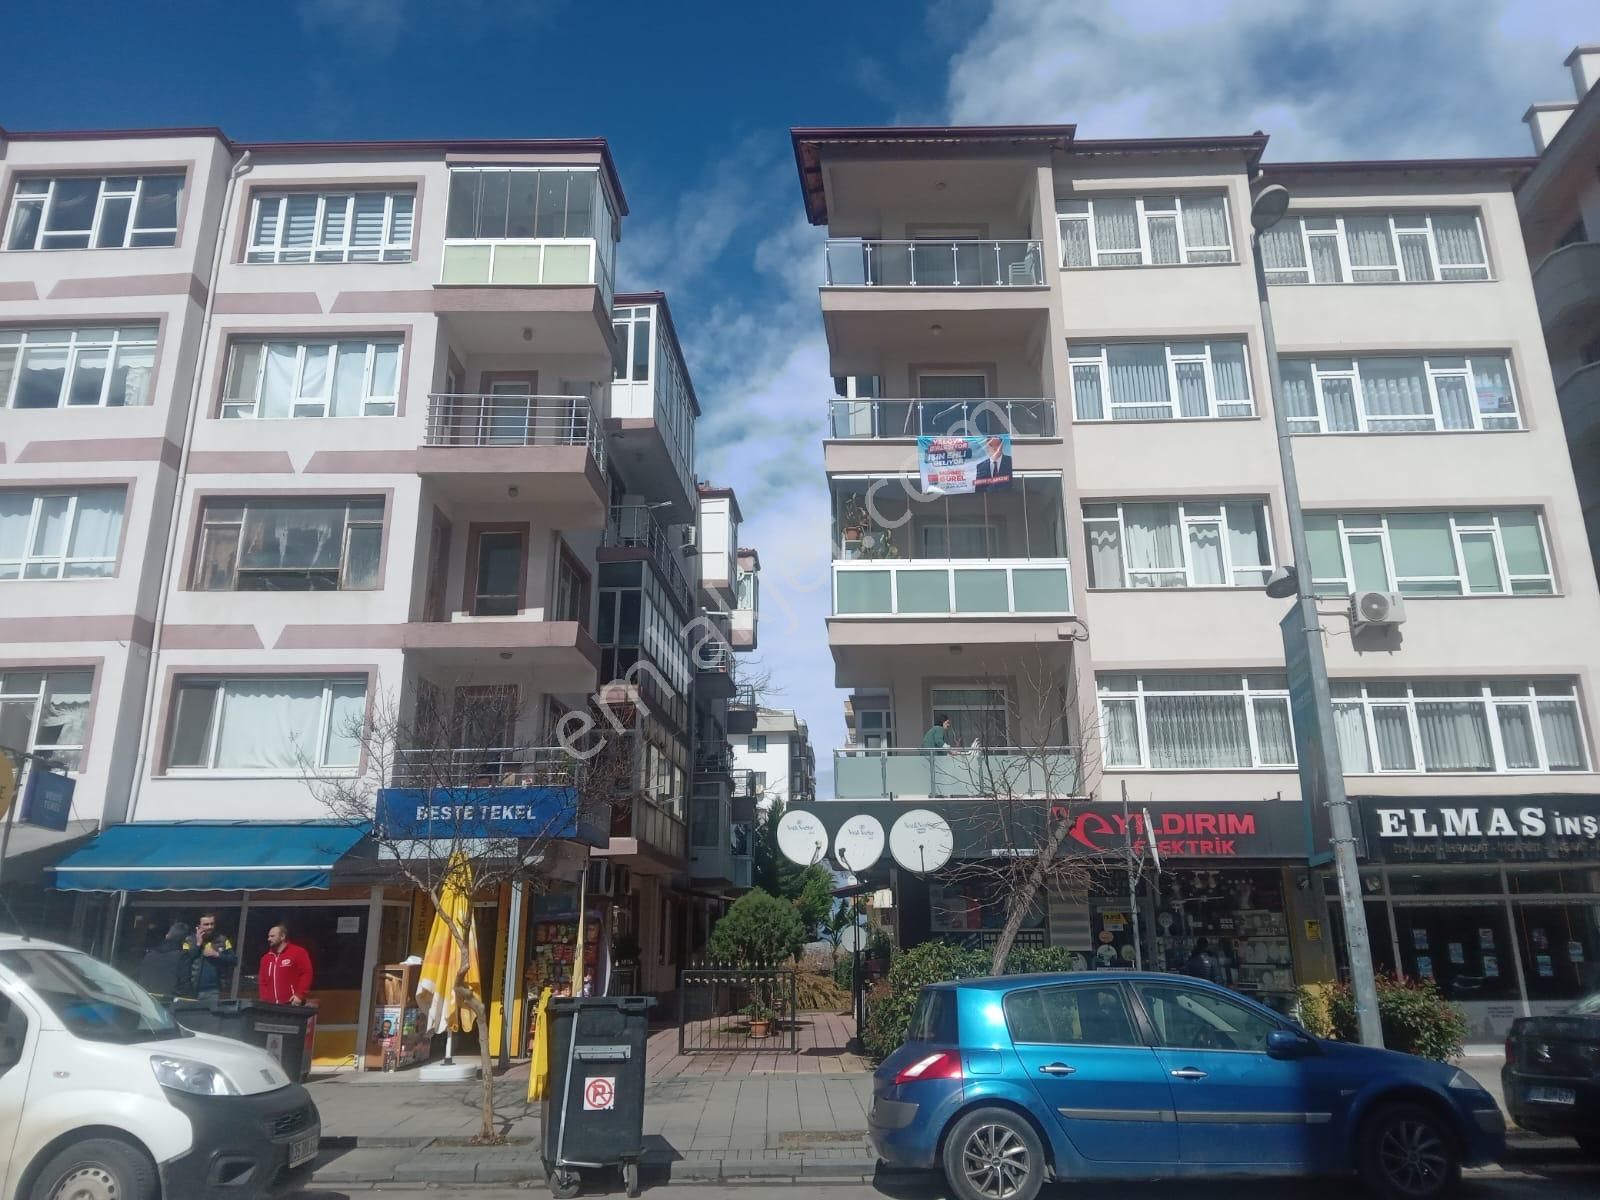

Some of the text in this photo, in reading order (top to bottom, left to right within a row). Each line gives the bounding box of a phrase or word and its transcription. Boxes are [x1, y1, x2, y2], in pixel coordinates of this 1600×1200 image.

[415, 805, 537, 821] BESTE TEKEL
[1376, 807, 1546, 838] ELMAS
[1134, 836, 1237, 856] EEKTRİK
